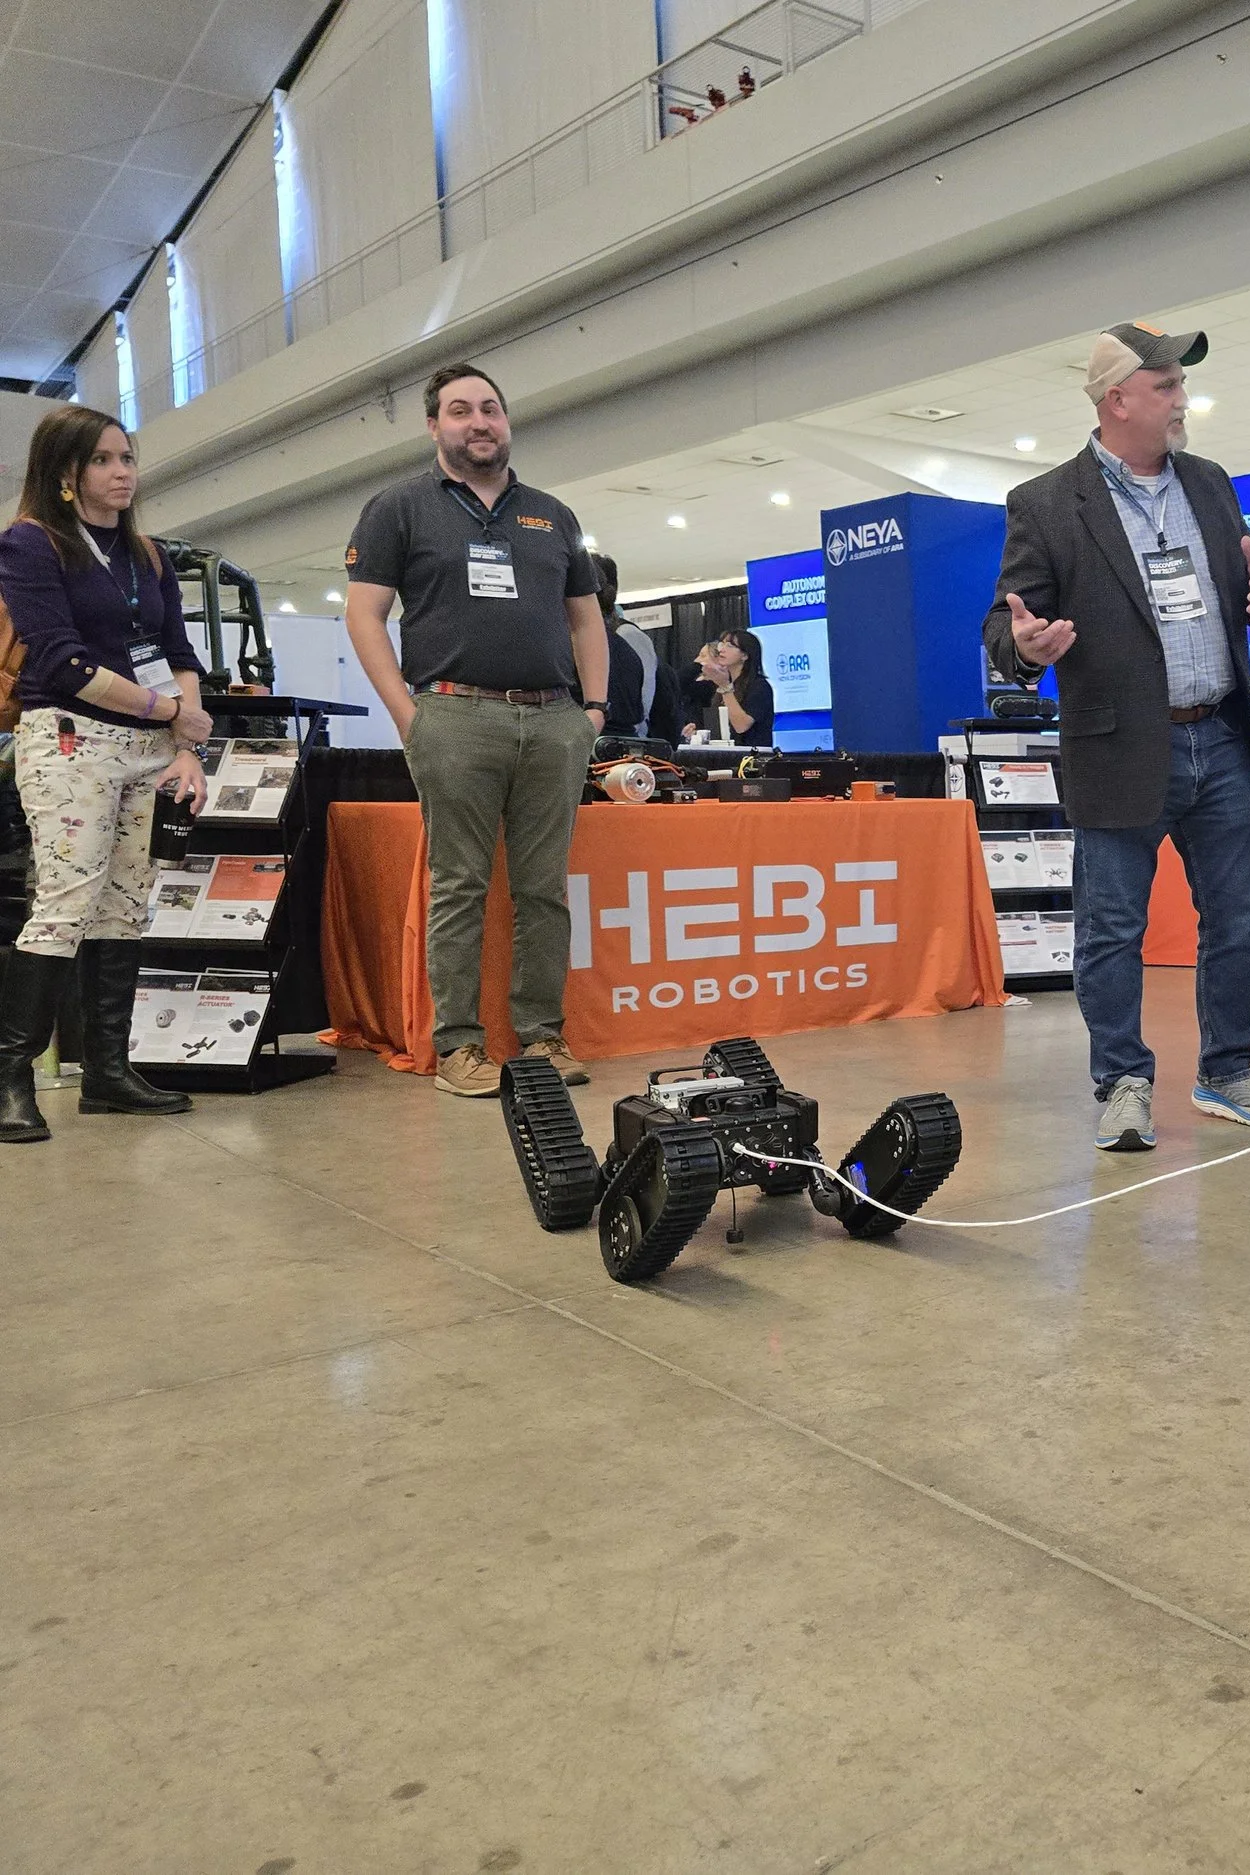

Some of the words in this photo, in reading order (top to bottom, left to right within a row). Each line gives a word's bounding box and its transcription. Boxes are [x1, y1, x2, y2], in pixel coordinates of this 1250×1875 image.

[848, 518, 903, 551] NEYA
[765, 593, 807, 610] COMPLEX
[788, 654, 810, 672] ARA
[567, 861, 898, 969] HEBI
[612, 963, 869, 1013] ROBOTICS
